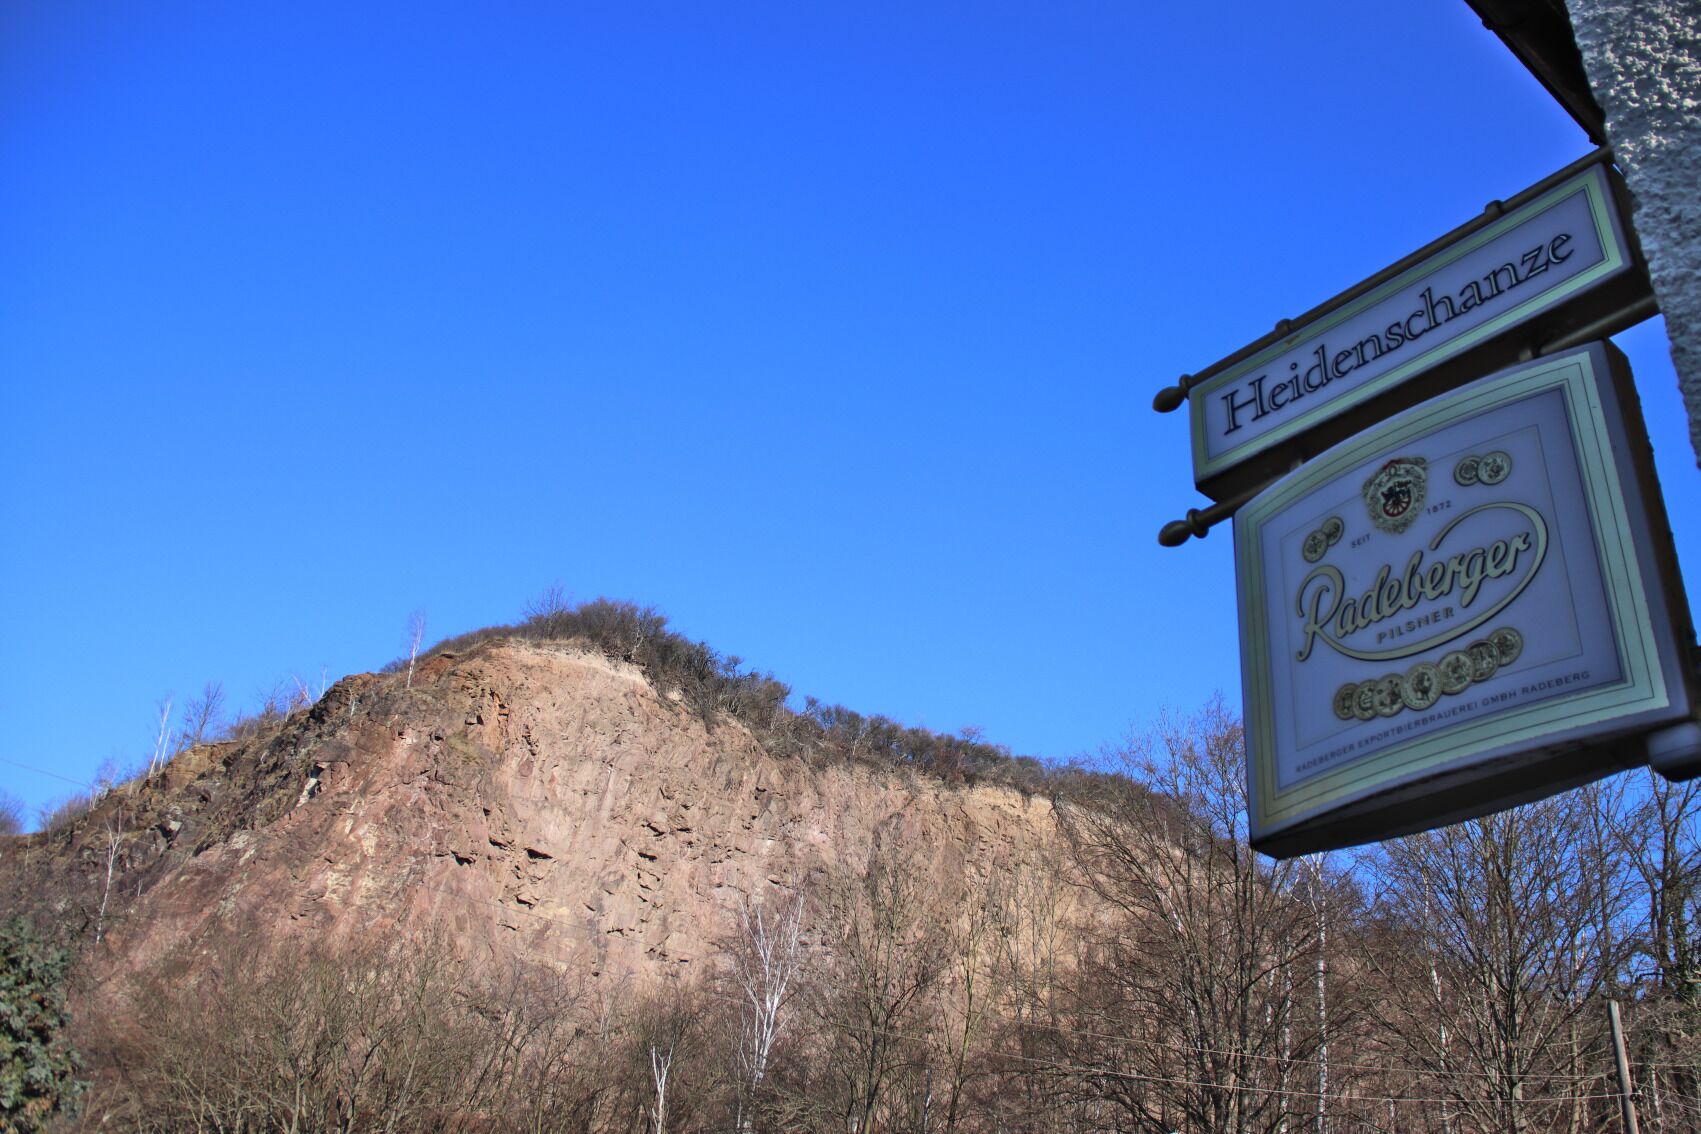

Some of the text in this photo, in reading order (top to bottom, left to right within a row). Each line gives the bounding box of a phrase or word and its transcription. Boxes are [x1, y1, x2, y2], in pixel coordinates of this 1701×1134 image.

[1221, 233, 1575, 436] Heidenschanze
[1351, 500, 1452, 549] SEIT 1872
[1296, 502, 1549, 662] Radeberger
[1376, 606, 1456, 644] PILSNER
[1295, 670, 1590, 773] RADEBERGER EXPORTBIERBRAUEREI GMBH RADEBERG
